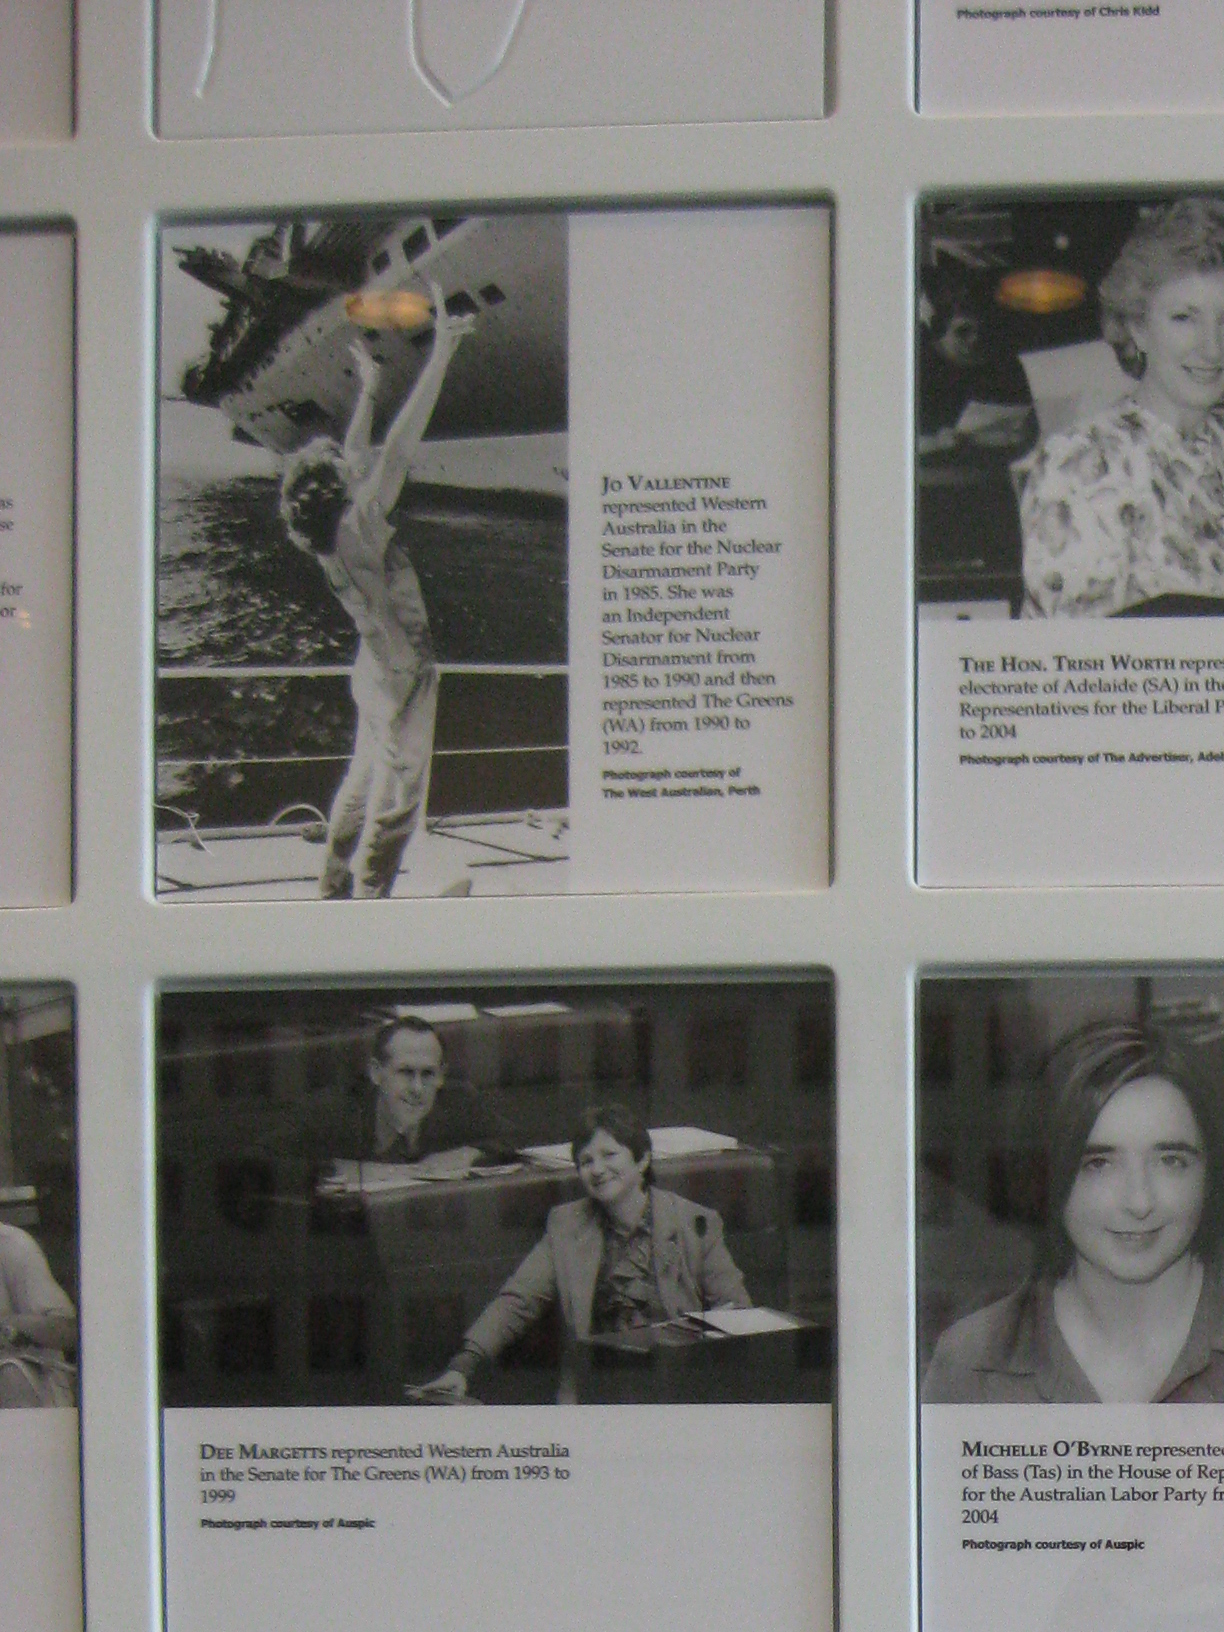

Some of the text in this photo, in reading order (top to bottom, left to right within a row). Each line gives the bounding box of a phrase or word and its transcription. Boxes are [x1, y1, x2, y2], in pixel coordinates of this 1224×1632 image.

[602, 496, 767, 518] represented Western
[602, 518, 727, 536] Australia in the
[601, 539, 782, 559] Senate for the Nuclear
[959, 723, 1017, 739] to 2004
[331, 1444, 423, 1463] represented
[428, 1444, 492, 1459] Western
[496, 1442, 570, 1459] Australia
[200, 1463, 570, 1484] in the Senate for The Greens (WA) from 1993 to
[961, 1464, 978, 1479] of
[983, 1464, 1019, 1479] Bass
[1024, 1464, 1062, 1482] (Tas)
[1067, 1465, 1083, 1479] in
[1088, 1464, 1114, 1479] the
[1118, 1464, 1171, 1479] House
[1176, 1464, 1192, 1479] of
[961, 1508, 999, 1525] 2004
[962, 1539, 1144, 1551] Photograph courtesy of Auspic
